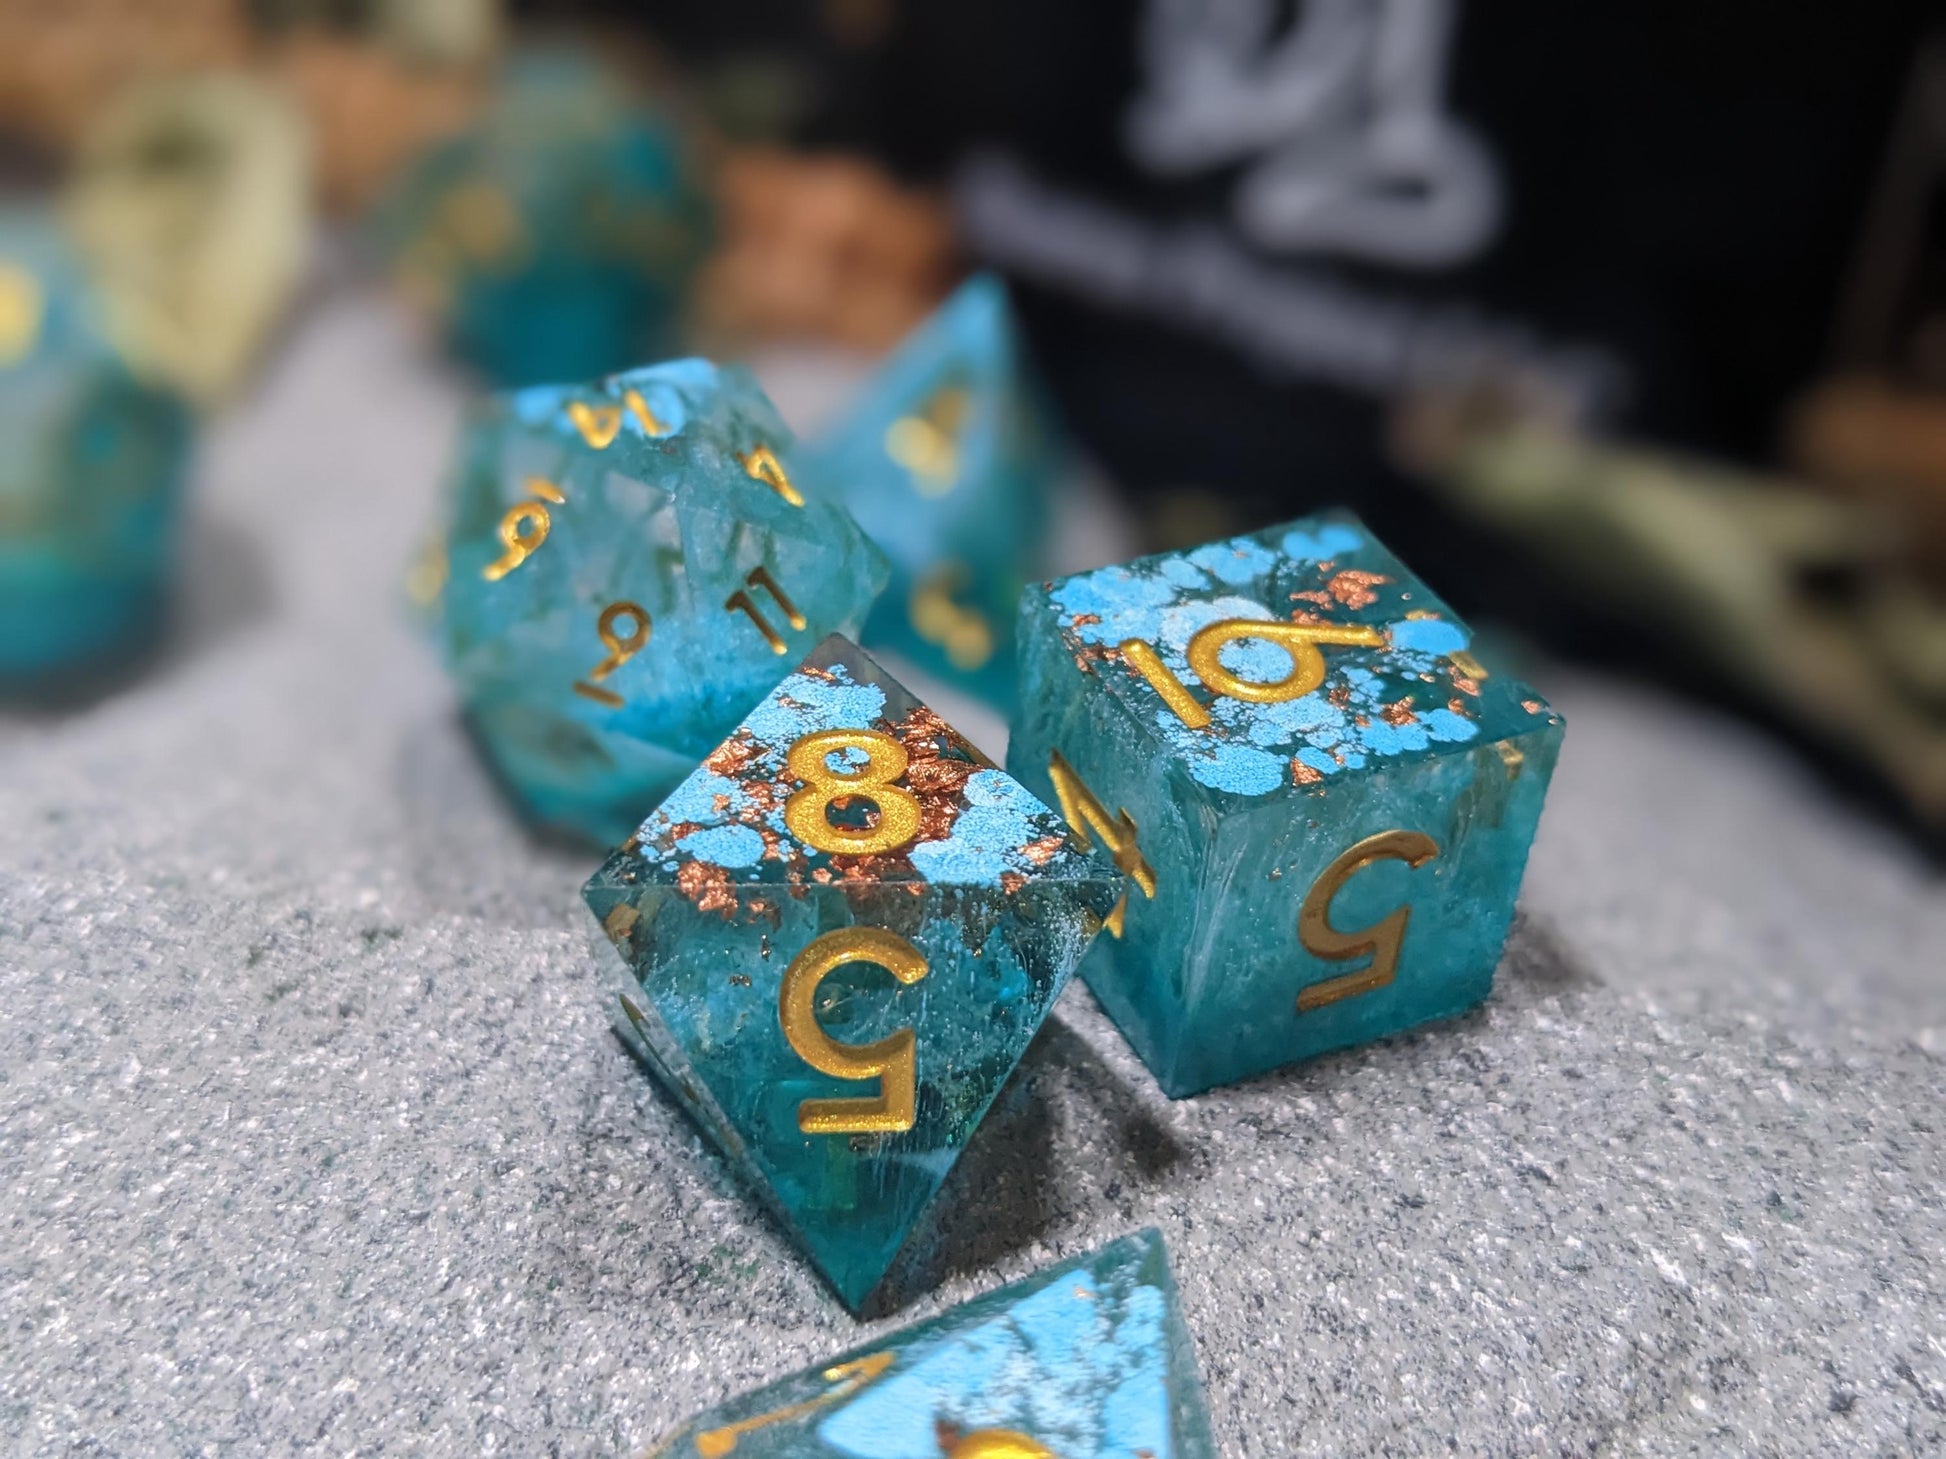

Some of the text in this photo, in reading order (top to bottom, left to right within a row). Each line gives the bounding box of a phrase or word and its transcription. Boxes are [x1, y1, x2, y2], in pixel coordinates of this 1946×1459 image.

[725, 566, 807, 656] 11
[784, 728, 922, 854] 8
[1296, 829, 1439, 1013] 5
[779, 926, 930, 1134] 5
